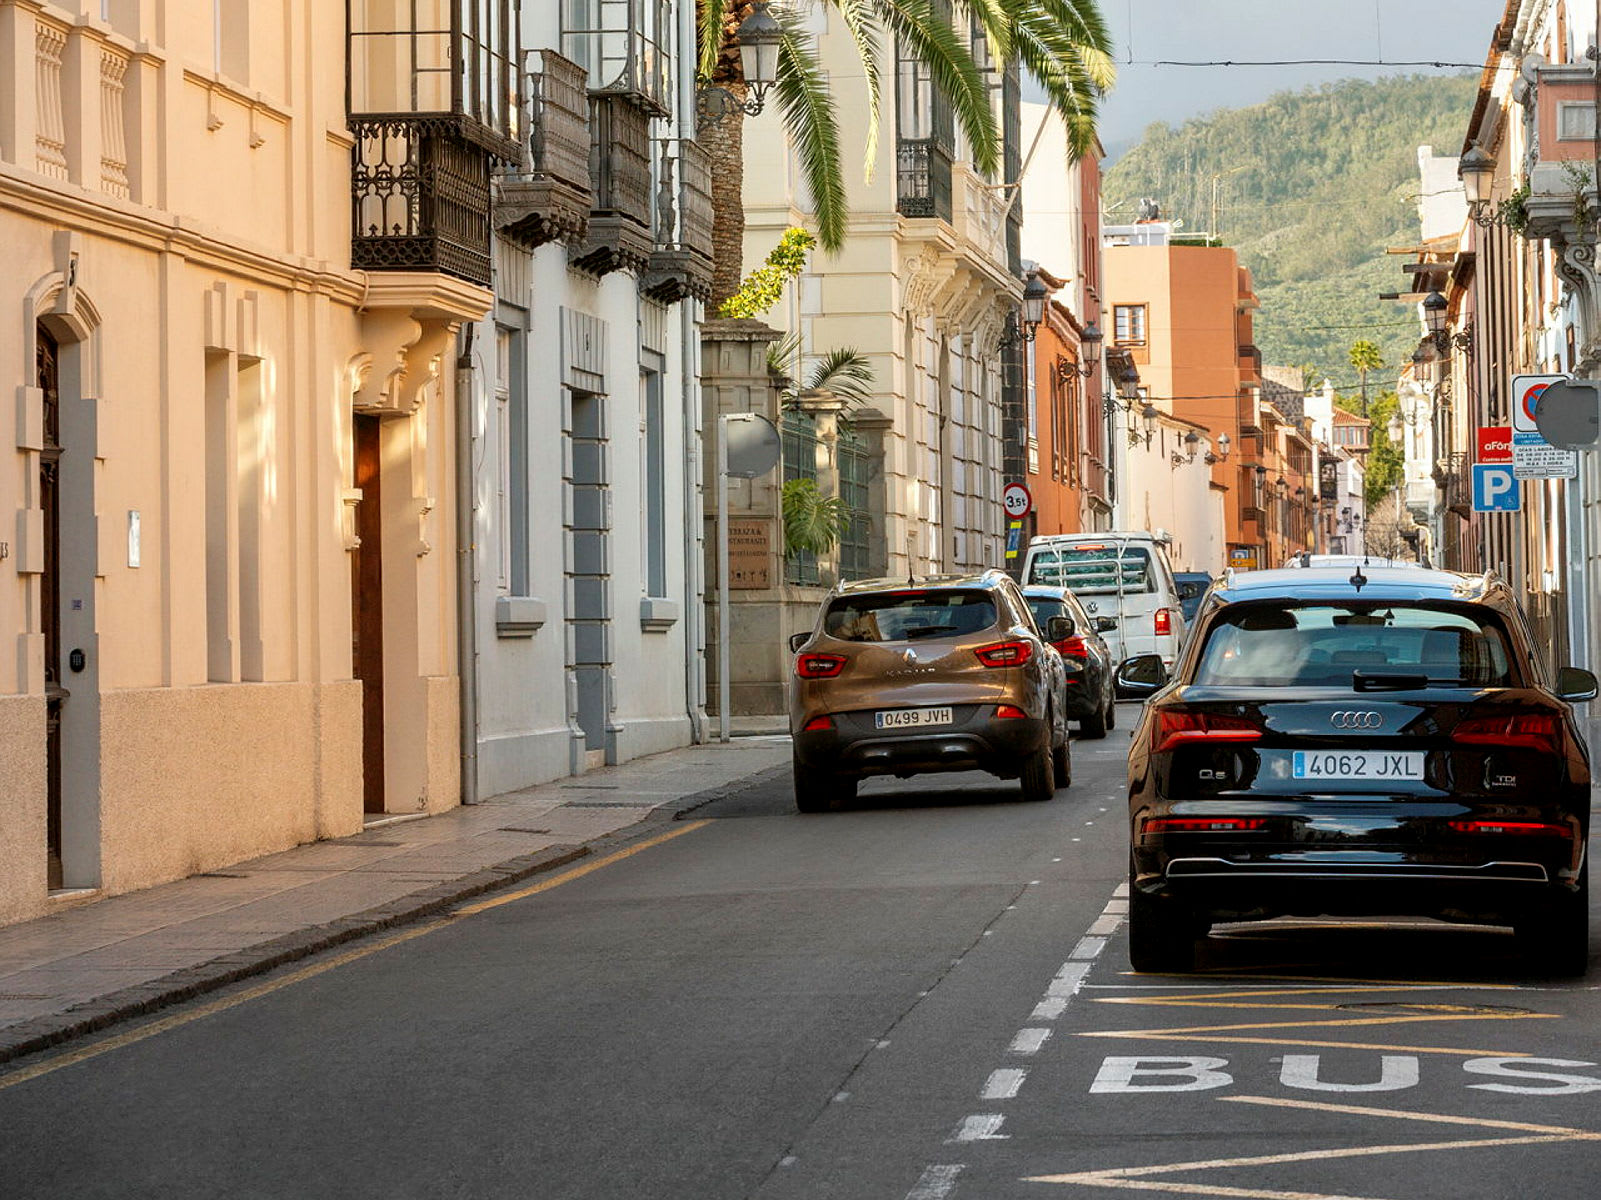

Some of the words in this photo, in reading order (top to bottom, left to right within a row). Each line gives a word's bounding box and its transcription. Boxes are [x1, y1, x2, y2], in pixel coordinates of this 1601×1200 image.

[1483, 470, 1512, 506] P
[885, 712, 919, 726] 0499
[925, 709, 949, 723] JVH
[1310, 755, 1366, 776] 4062
[1376, 756, 1418, 776] JXL
[1089, 1054, 1601, 1095] BUS
